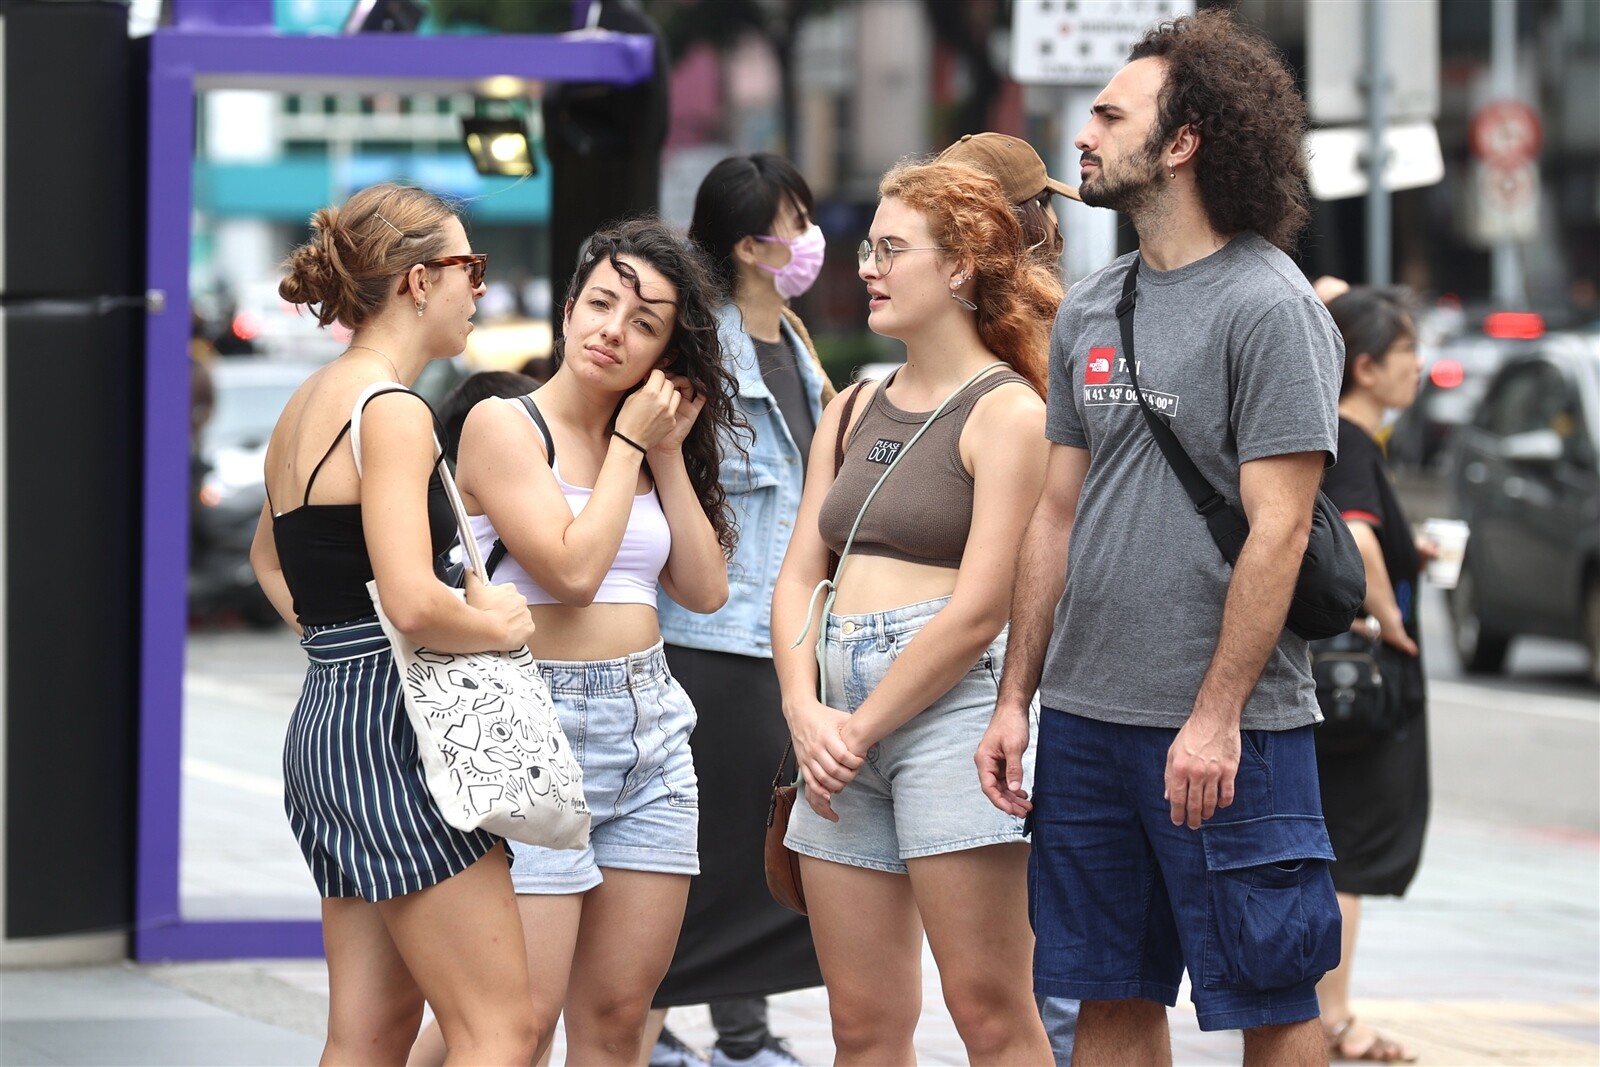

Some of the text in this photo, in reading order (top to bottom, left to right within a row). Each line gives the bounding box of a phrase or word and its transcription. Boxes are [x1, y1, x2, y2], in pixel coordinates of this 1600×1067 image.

[1085, 389, 1091, 401] N
[875, 440, 900, 449] PLEASE
[868, 446, 897, 463] DO IT
